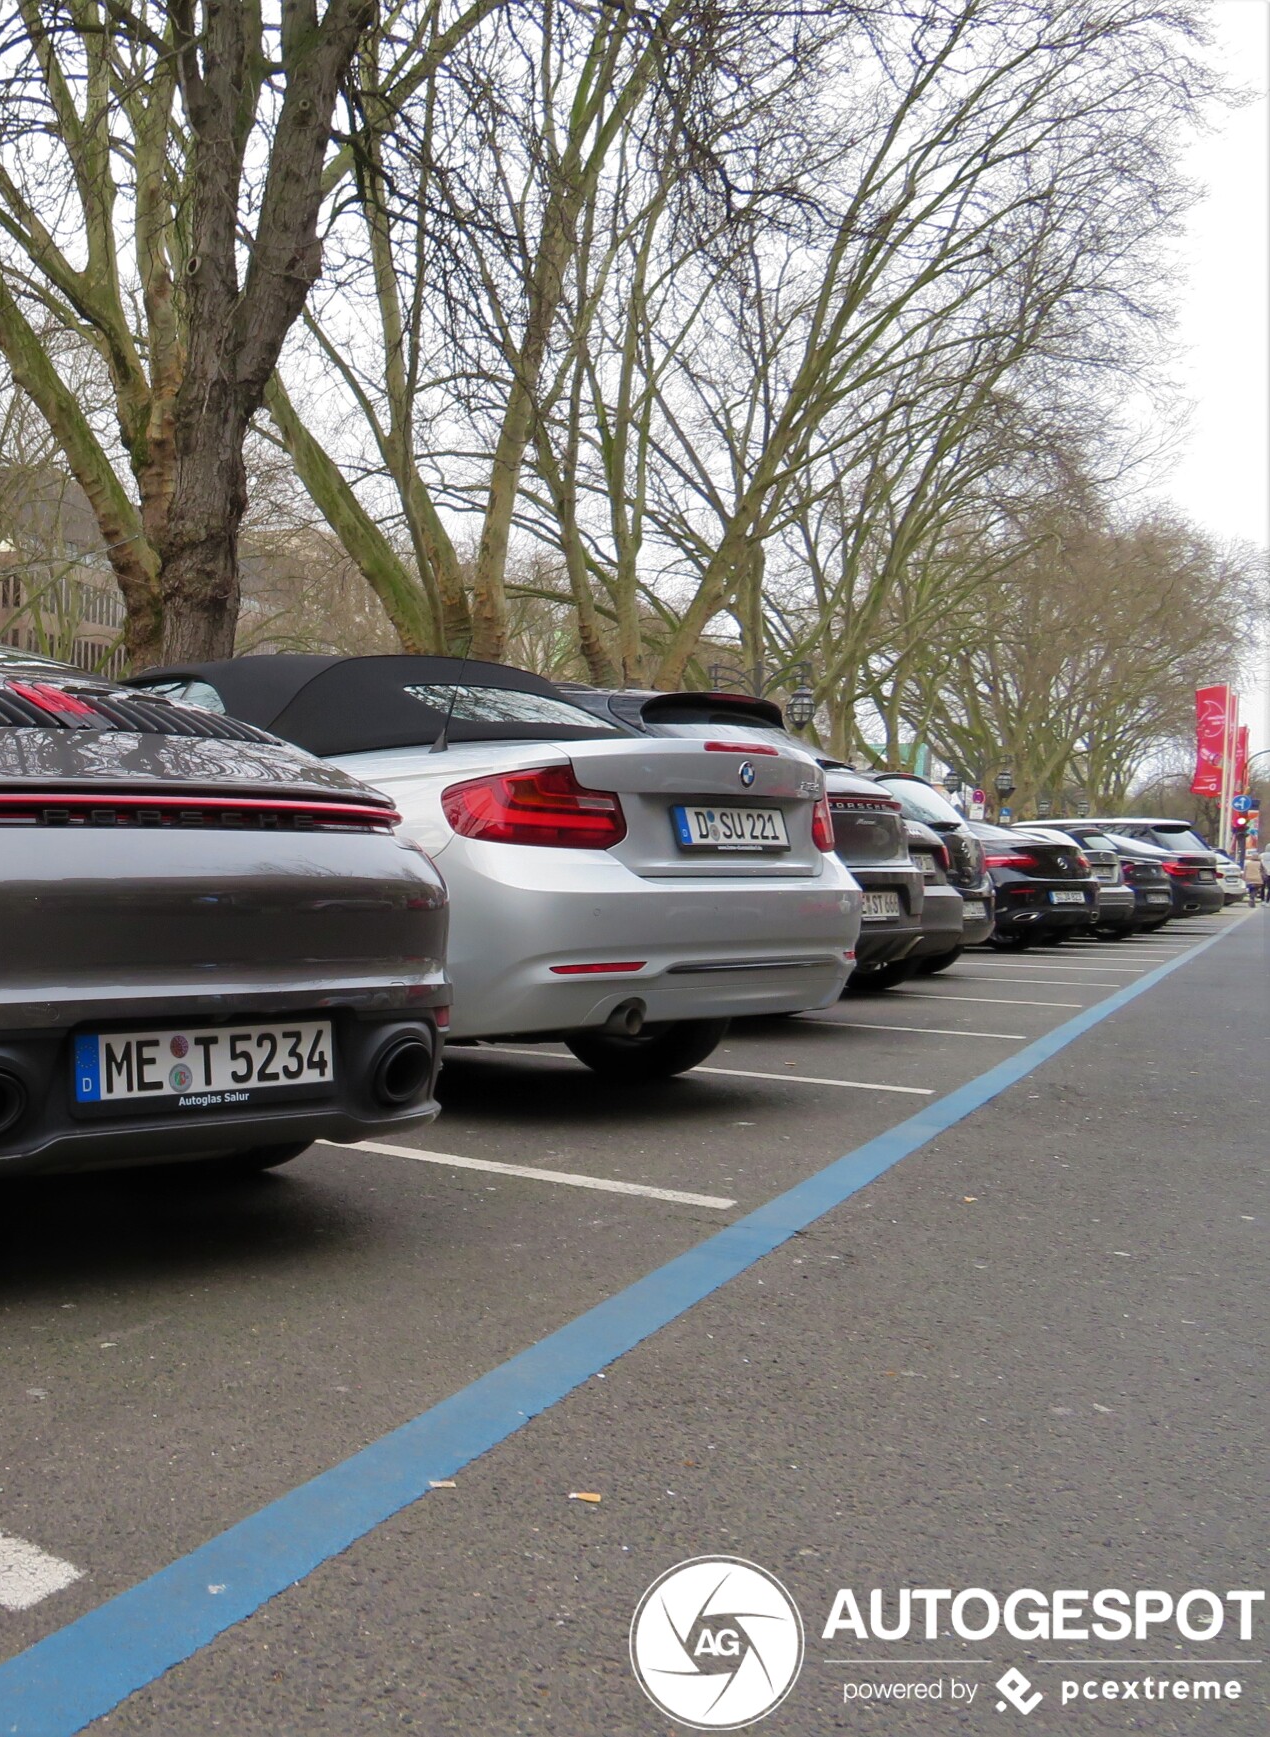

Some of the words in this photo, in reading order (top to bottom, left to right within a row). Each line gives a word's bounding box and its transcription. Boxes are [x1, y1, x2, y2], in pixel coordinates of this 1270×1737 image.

[43, 809, 314, 829] PORSCHE
[694, 811, 709, 839] D
[720, 811, 745, 840] SU
[746, 812, 780, 841] 221
[82, 1077, 92, 1092] D
[105, 1039, 164, 1094] ME
[194, 1036, 218, 1086] T
[229, 1029, 328, 1084] 5234
[178, 1094, 222, 1107] Autoglas
[224, 1091, 250, 1104] Salur
